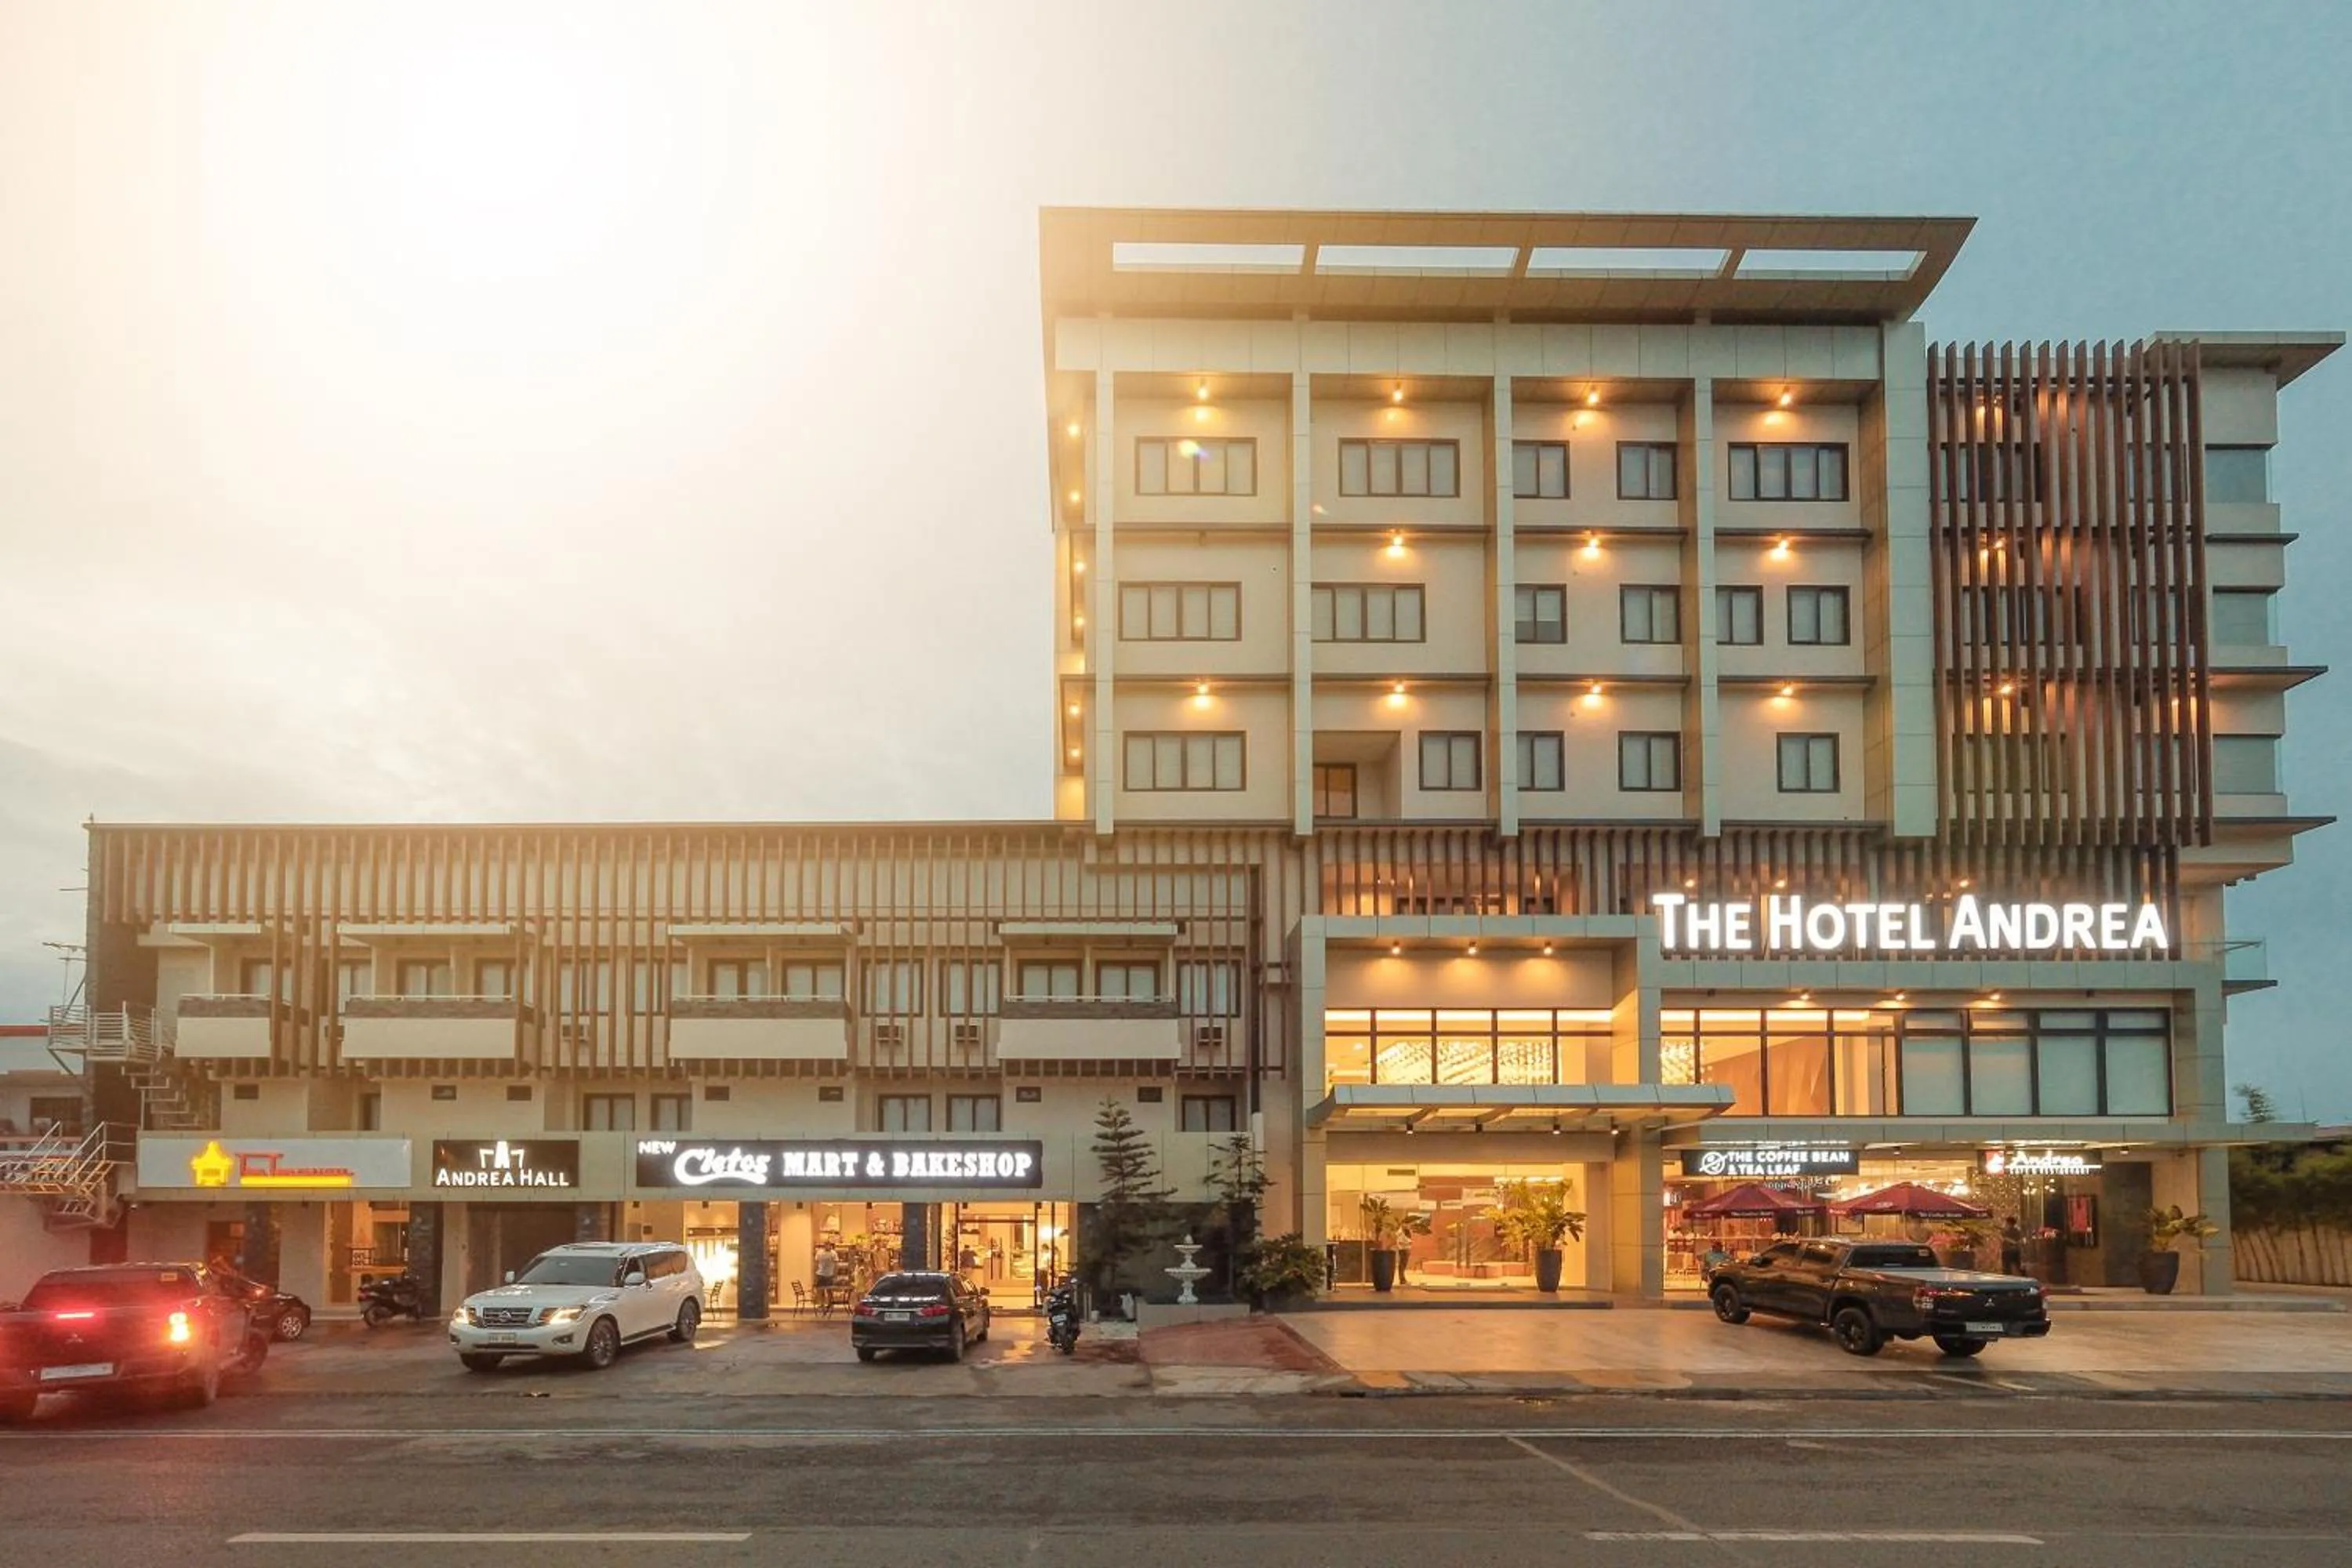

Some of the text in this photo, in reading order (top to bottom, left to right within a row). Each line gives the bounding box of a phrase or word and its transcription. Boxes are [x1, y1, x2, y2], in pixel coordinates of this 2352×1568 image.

[1653, 894, 2169, 950] THE HOTEL ANDREA
[638, 1141, 676, 1155] NEW
[782, 1152, 859, 1177] MART
[866, 1152, 885, 1177] &
[892, 1152, 1033, 1177] BAKESHOP
[1728, 1151, 1849, 1163] THE COFFEE BEAN
[436, 1167, 570, 1186] ANDREA HALL
[1738, 1164, 1764, 1175] TEA
[1766, 1164, 1802, 1175] LEAF
